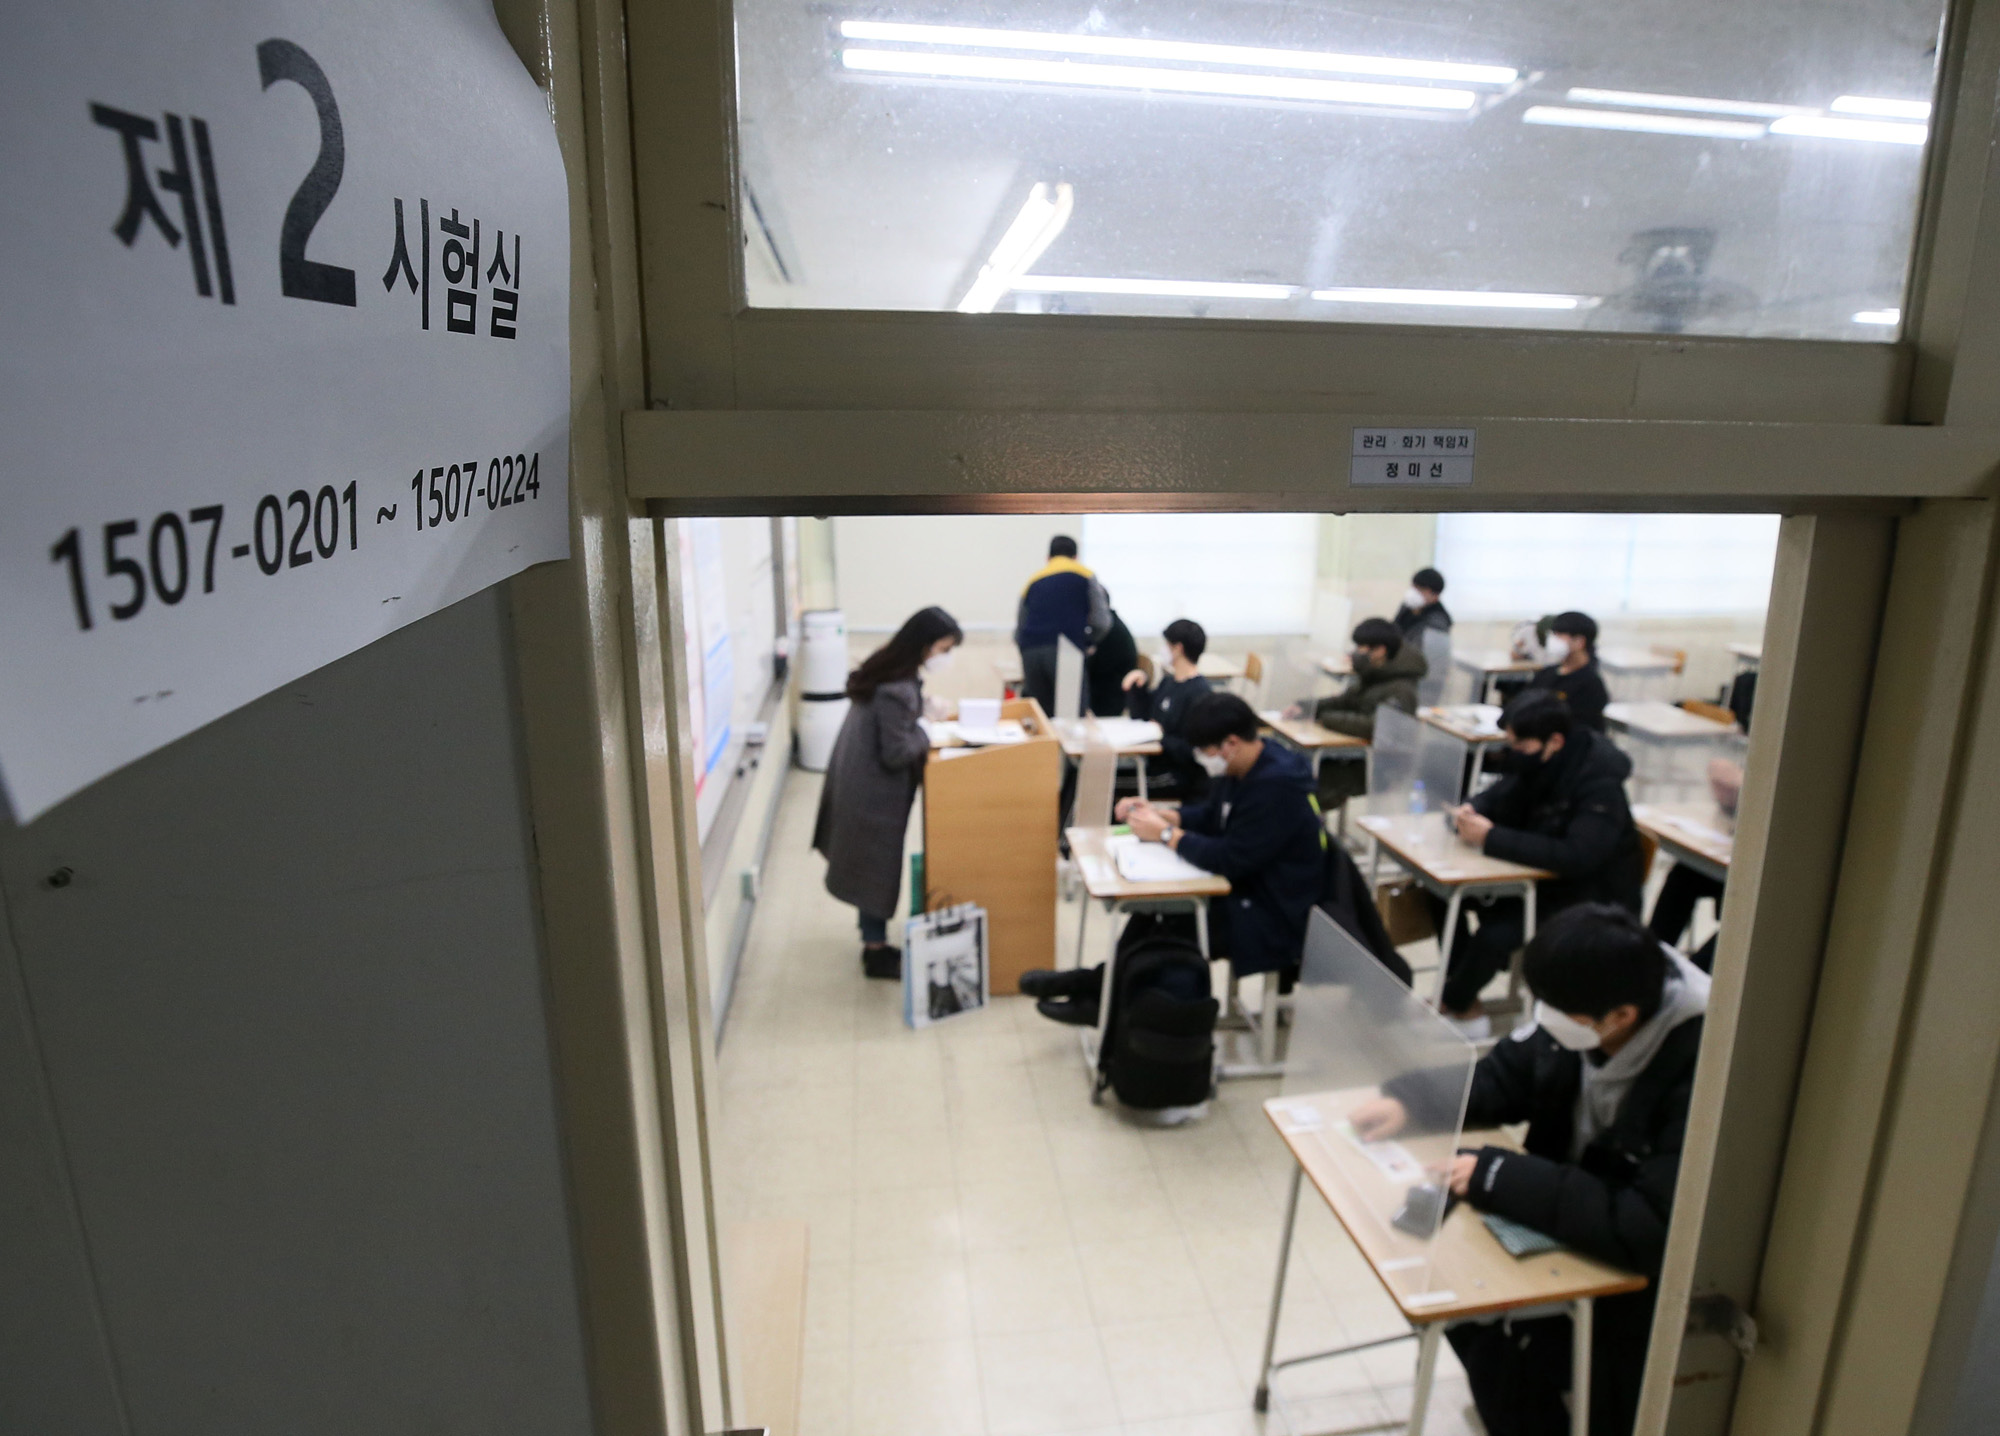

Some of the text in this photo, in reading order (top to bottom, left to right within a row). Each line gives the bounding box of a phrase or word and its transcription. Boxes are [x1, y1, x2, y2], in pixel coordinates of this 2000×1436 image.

[89, 37, 521, 340] 제 2 시험실
[1363, 435, 1469, 448] 관리 화기 책임자
[50, 480, 359, 632] 1507-0201
[411, 452, 540, 531] 1507-0224
